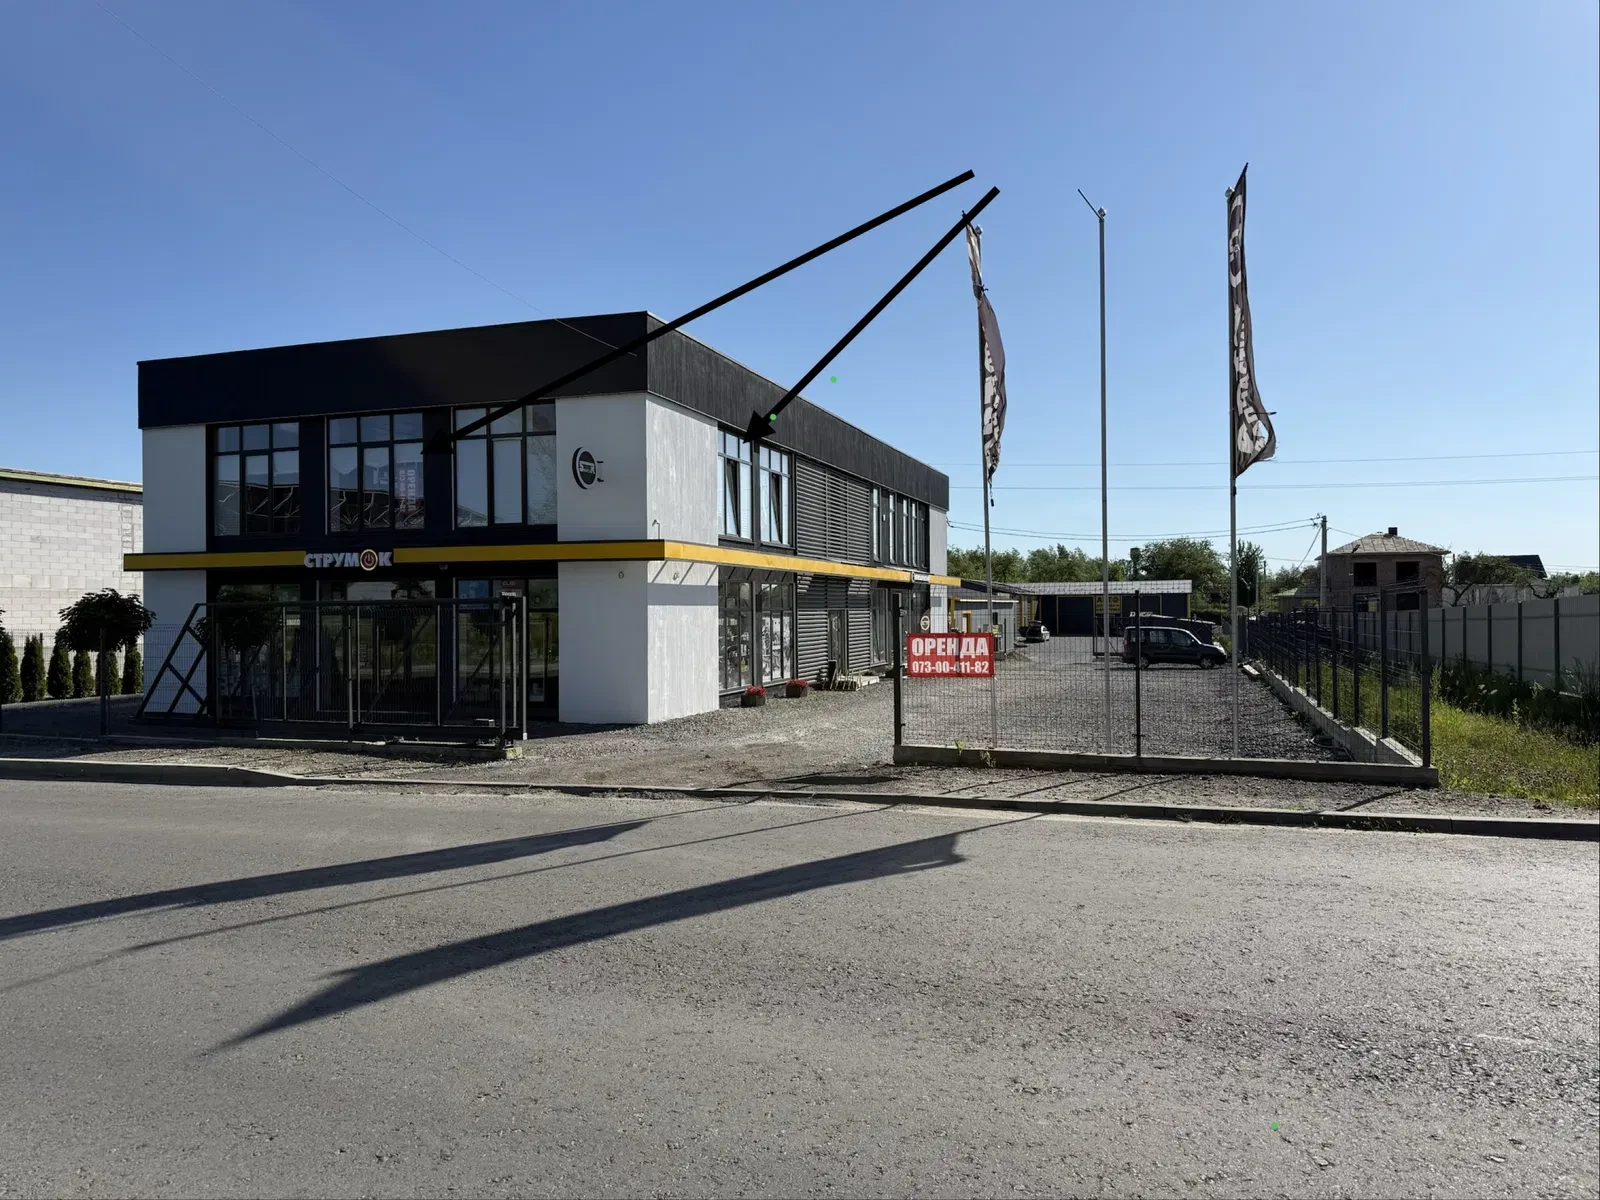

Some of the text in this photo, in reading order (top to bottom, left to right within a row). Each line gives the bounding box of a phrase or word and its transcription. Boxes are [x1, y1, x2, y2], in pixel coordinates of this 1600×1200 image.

[304, 549, 392, 571] СТРУМОК
[912, 637, 989, 658] ОРЕНДА
[912, 661, 989, 673] 073-00-411-82
